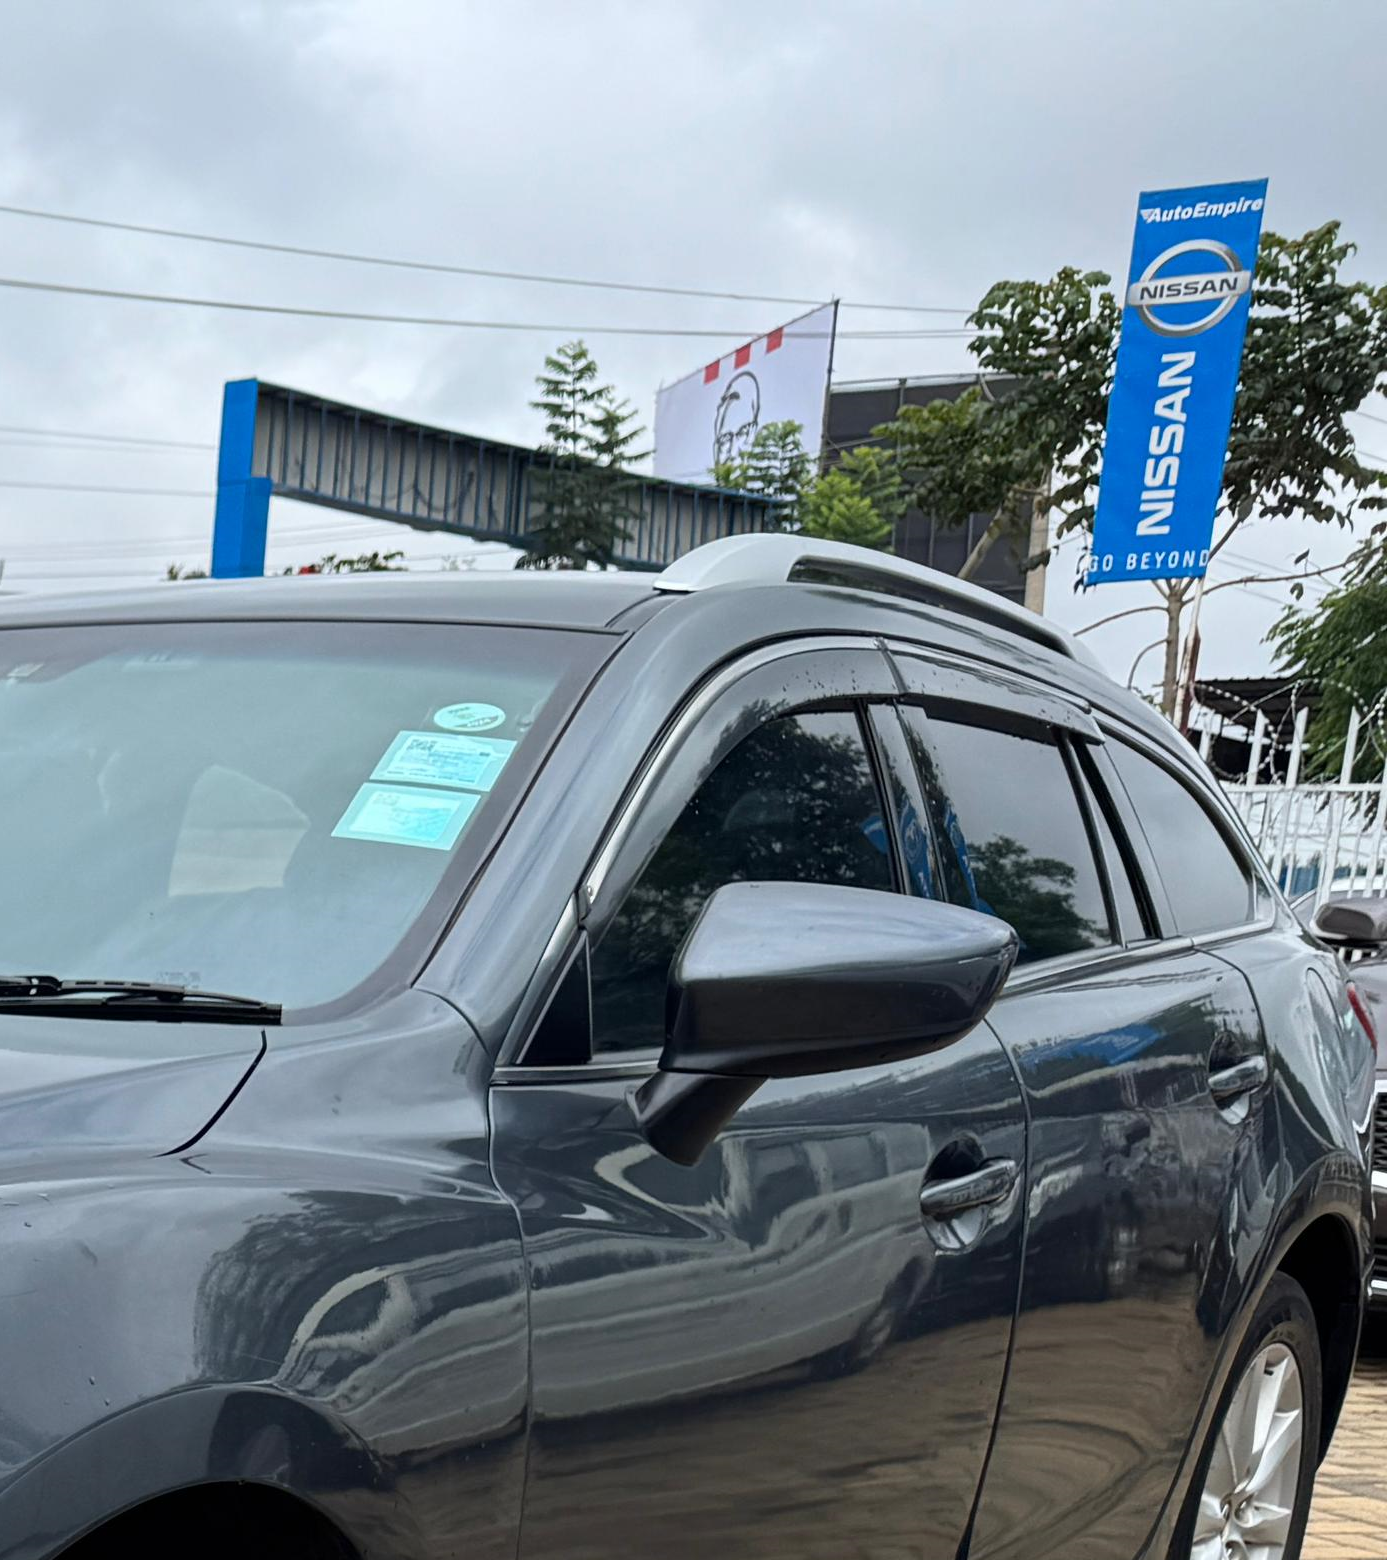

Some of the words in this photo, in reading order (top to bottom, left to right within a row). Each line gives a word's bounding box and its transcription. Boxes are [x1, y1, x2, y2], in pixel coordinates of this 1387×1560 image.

[1145, 196, 1264, 225] AutoEmpire
[1139, 276, 1239, 301] NISSAN
[1136, 350, 1196, 537] NISSAN
[1088, 554, 1114, 573] GO
[1125, 549, 1209, 571] BEYOND
